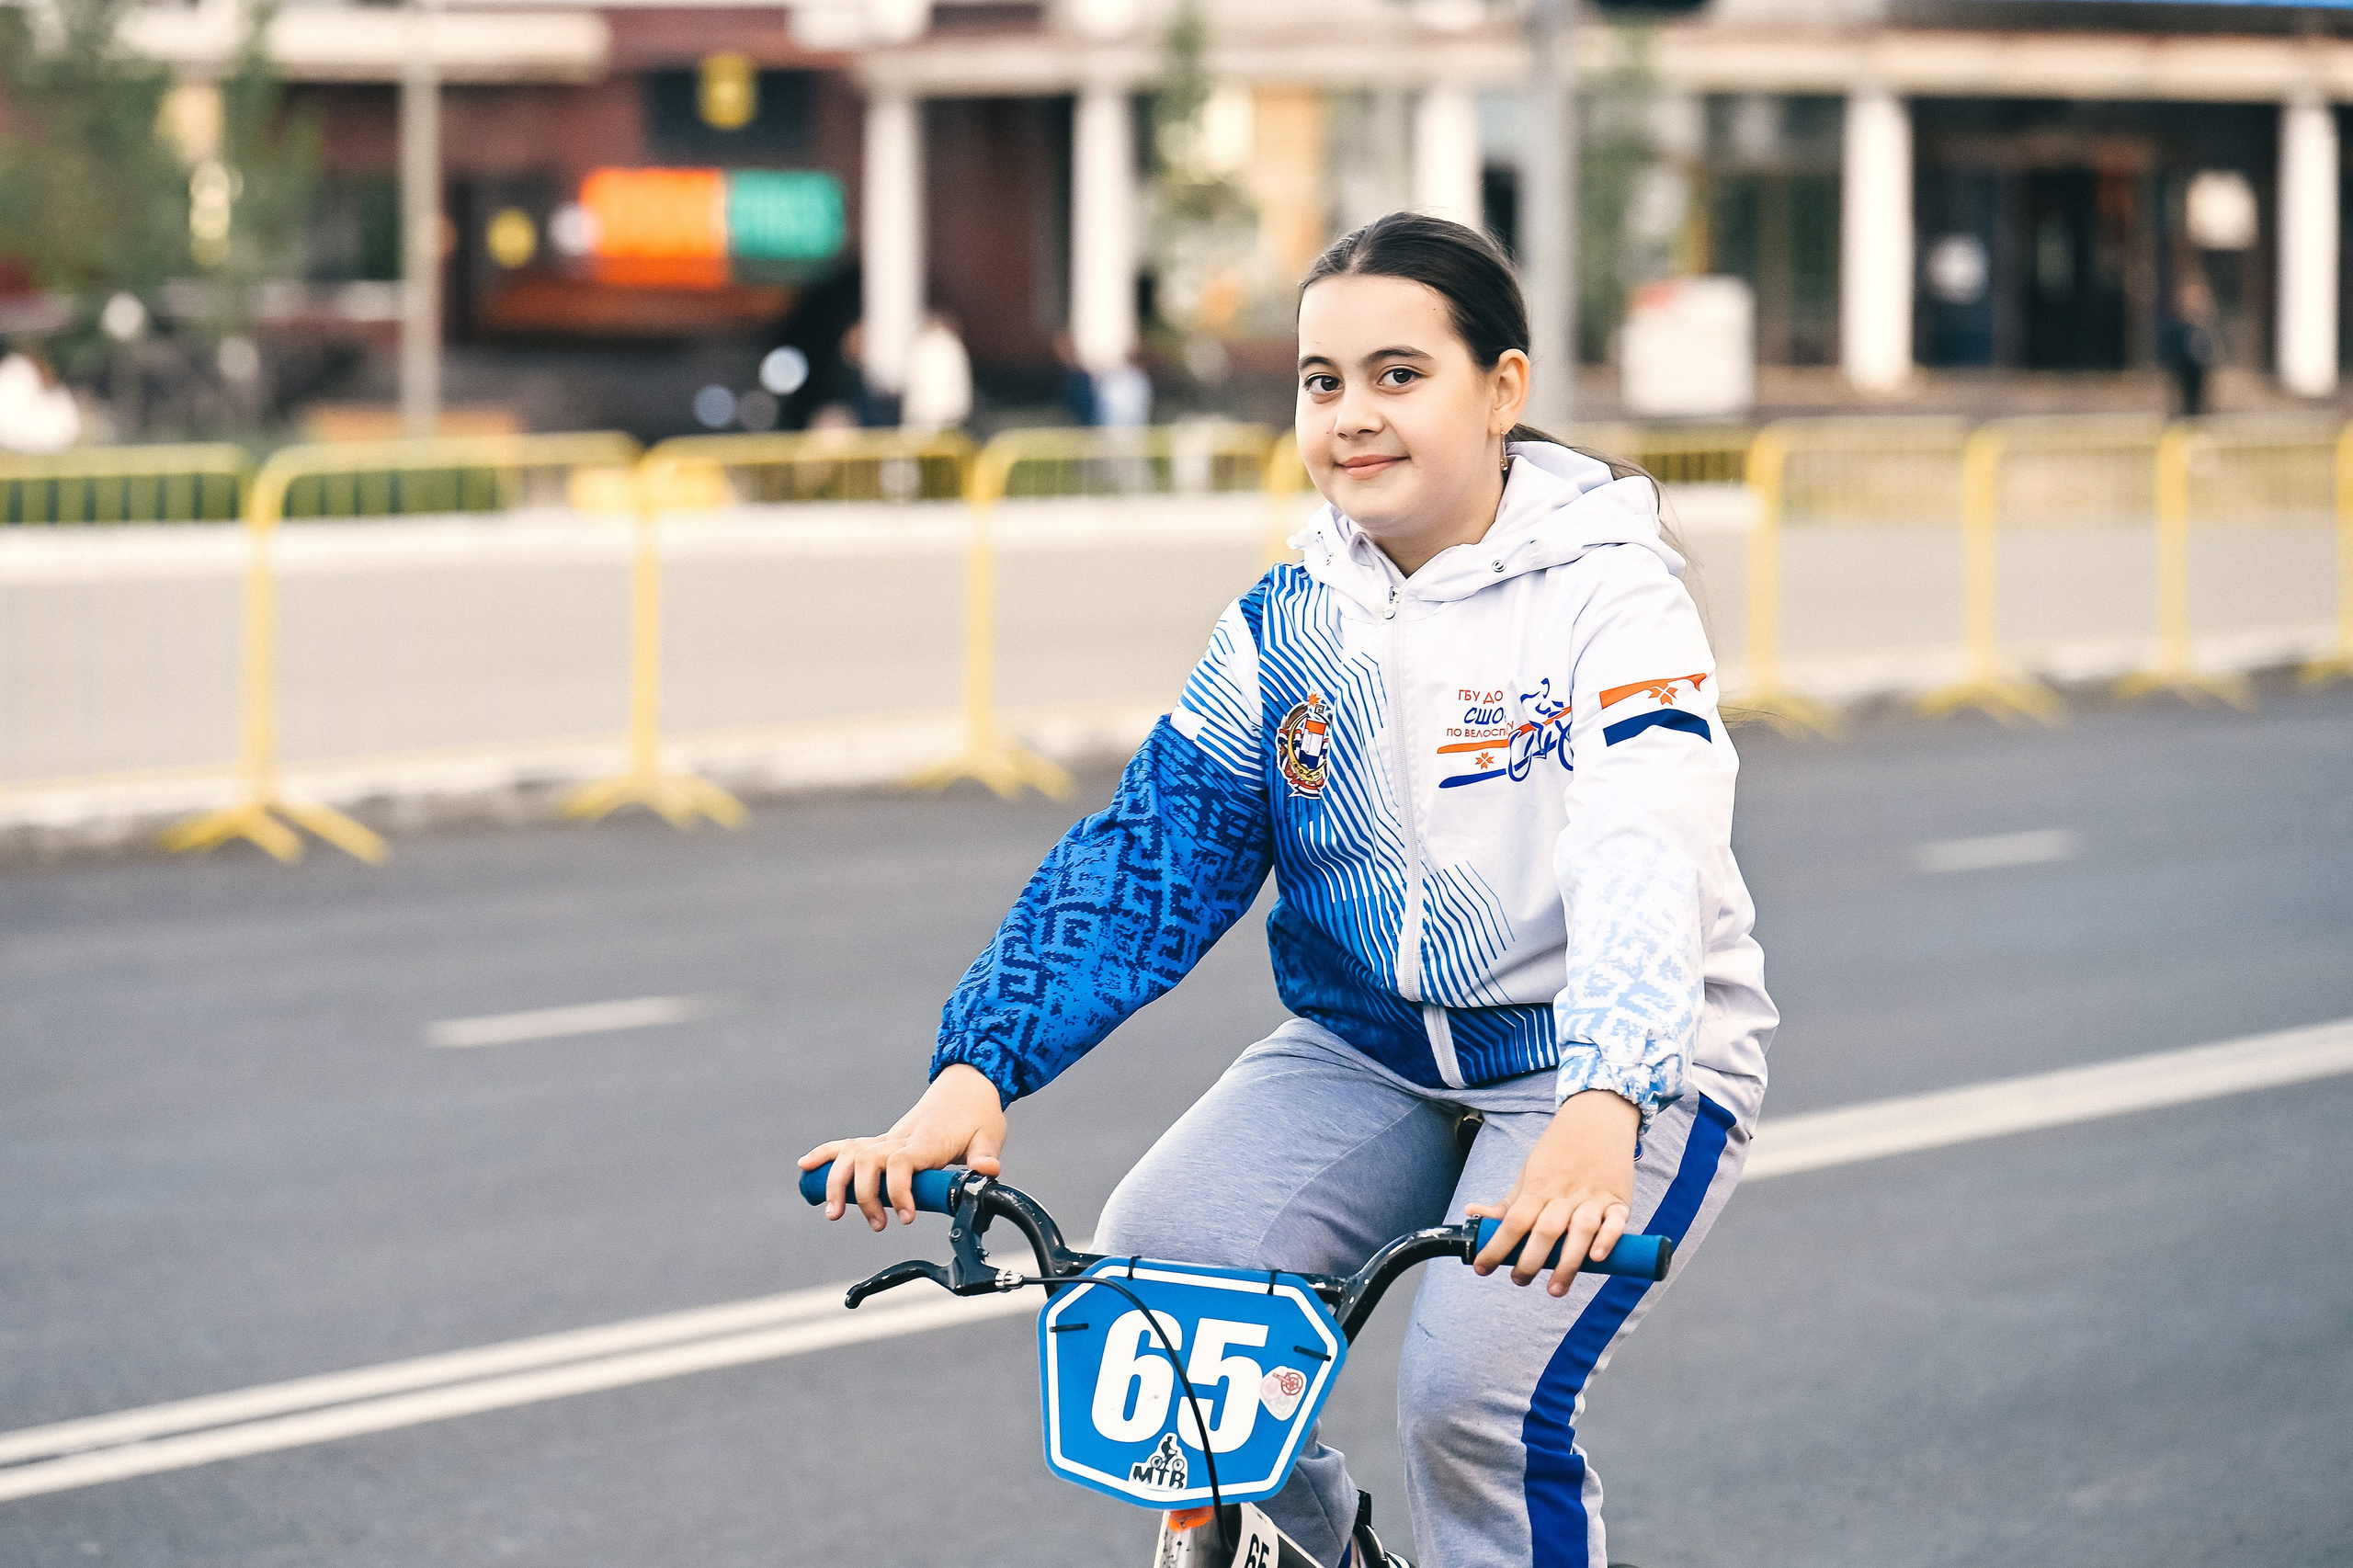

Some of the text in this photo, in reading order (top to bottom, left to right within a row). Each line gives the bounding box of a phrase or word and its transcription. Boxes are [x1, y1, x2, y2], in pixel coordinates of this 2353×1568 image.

[1458, 689, 1504, 705] ГБУ ДО
[1463, 707, 1507, 725] СШО
[1446, 728, 1462, 737] ПО
[1091, 1309, 1270, 1454] 65
[1244, 1533, 1270, 1568] 65
